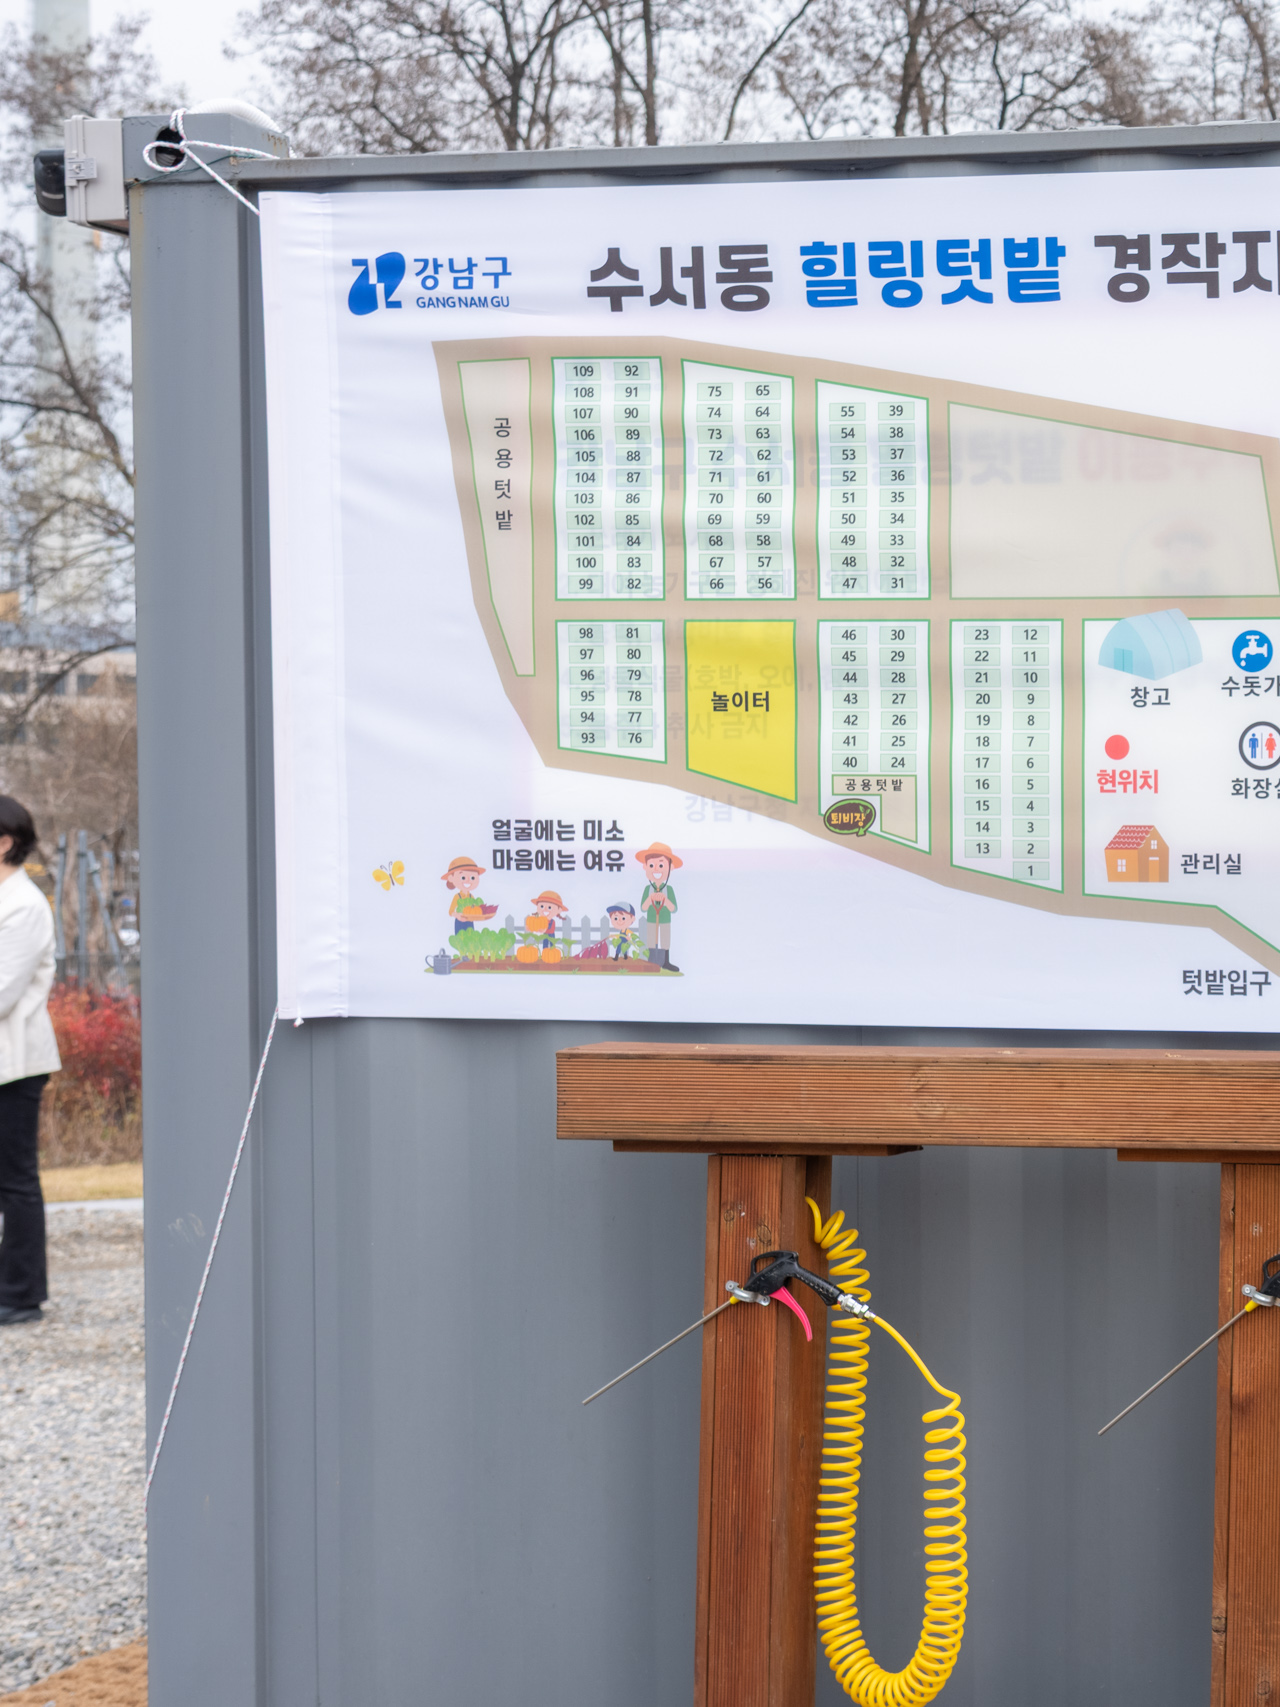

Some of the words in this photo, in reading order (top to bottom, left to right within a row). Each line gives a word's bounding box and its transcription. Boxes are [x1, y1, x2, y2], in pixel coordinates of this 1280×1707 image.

[413, 256, 512, 291] 강남구
[586, 244, 774, 313] 수서동
[799, 240, 1067, 308] 힐링텃밭
[415, 296, 457, 309] GANG
[457, 296, 489, 308] NAM
[490, 295, 510, 308] GU
[573, 365, 594, 377] 109
[624, 364, 639, 377] 92
[573, 386, 595, 398] 108
[625, 386, 638, 398] 91
[707, 385, 722, 397] 75
[755, 384, 770, 396] 65
[573, 407, 594, 420] 107
[624, 407, 639, 419] 90
[707, 407, 722, 418] 74
[755, 406, 770, 418] 64
[840, 405, 855, 418] 55
[889, 404, 904, 417] 39
[574, 429, 595, 441] 106
[625, 428, 641, 441] 89
[707, 428, 723, 440] 73
[755, 427, 771, 439] 63
[841, 427, 856, 439] 54
[889, 426, 904, 439] 38
[575, 450, 596, 462] 105
[626, 450, 641, 462] 88
[708, 450, 723, 462] 72
[756, 449, 772, 461] 62
[842, 448, 856, 461] 53
[890, 448, 905, 460] 37
[493, 417, 514, 531] 공용텃밭
[575, 472, 596, 484] 104
[626, 471, 641, 483] 87
[708, 471, 722, 483] 71
[756, 470, 770, 483] 61
[842, 470, 857, 482] 52
[890, 469, 905, 482] 36
[574, 492, 595, 504] 103
[625, 493, 641, 504] 86
[708, 492, 724, 504] 70
[756, 492, 772, 504] 60
[842, 491, 855, 504] 51
[890, 491, 905, 503] 35
[574, 514, 595, 526] 102
[625, 514, 640, 526] 85
[707, 513, 722, 525] 69
[755, 513, 771, 525] 59
[841, 513, 856, 525] 50
[890, 512, 905, 524] 34
[575, 535, 595, 547] 101
[626, 535, 641, 547] 84
[708, 535, 724, 547] 68
[756, 534, 771, 547] 58
[840, 534, 856, 546] 49
[890, 534, 905, 546] 33
[576, 557, 597, 569] 100
[627, 556, 642, 568] 83
[709, 556, 724, 568] 67
[757, 556, 772, 568] 57
[841, 555, 857, 568] 48
[890, 555, 905, 568] 32
[578, 578, 594, 590] 99
[627, 578, 642, 590] 82
[709, 578, 725, 590] 66
[757, 577, 773, 589] 56
[842, 577, 858, 589] 47
[891, 577, 904, 589] 31
[578, 627, 594, 639] 98
[626, 627, 639, 639] 81
[841, 629, 857, 641] 46
[890, 629, 905, 641] 30
[974, 628, 990, 641] 23
[1023, 628, 1038, 641] 12
[579, 648, 594, 660] 97
[626, 648, 642, 660] 80
[841, 650, 857, 662] 45
[890, 650, 905, 662] 29
[974, 650, 989, 662] 22
[1023, 650, 1036, 663] 11
[580, 669, 595, 681] 96
[627, 669, 642, 681] 79
[842, 671, 858, 683] 44
[891, 671, 906, 684] 28
[975, 671, 988, 683] 21
[1023, 671, 1038, 684] 10
[580, 690, 595, 702] 95
[627, 690, 642, 702] 78
[710, 690, 770, 713] 놀이터
[843, 692, 858, 705] 43
[891, 693, 907, 705] 27
[975, 693, 991, 705] 20
[1027, 693, 1035, 705] 9
[1130, 686, 1171, 708] 창고
[580, 711, 595, 723] 94
[627, 711, 642, 723] 77
[843, 714, 859, 726] 42
[891, 714, 907, 726] 26
[976, 714, 991, 726] 19
[1027, 714, 1035, 726] 8
[581, 732, 596, 744] 93
[627, 732, 643, 744] 76
[842, 735, 856, 747] 41
[891, 735, 906, 747] 25
[975, 735, 990, 748] 18
[1026, 736, 1035, 748] 7
[842, 756, 858, 768] 40
[890, 756, 906, 768] 24
[975, 757, 990, 769] 17
[1026, 757, 1035, 769] 6
[845, 778, 903, 792] 공용텃밭
[975, 778, 990, 790] 16
[1026, 778, 1034, 791] 5
[1096, 769, 1159, 794] 현위치
[975, 799, 990, 812] 15
[1026, 800, 1035, 812] 4
[830, 812, 866, 827] 퇴비장
[491, 819, 576, 842] 얼굴에는
[583, 819, 625, 842] 미소
[975, 821, 990, 833] 14
[1027, 821, 1035, 833] 3
[976, 842, 990, 855] 13
[1027, 843, 1035, 855] 2
[492, 848, 576, 872] 마음에는
[583, 849, 625, 872] 여유
[1180, 853, 1242, 875] 관리실
[1026, 864, 1034, 877] 1
[1182, 969, 1272, 997] 텃밭입구
